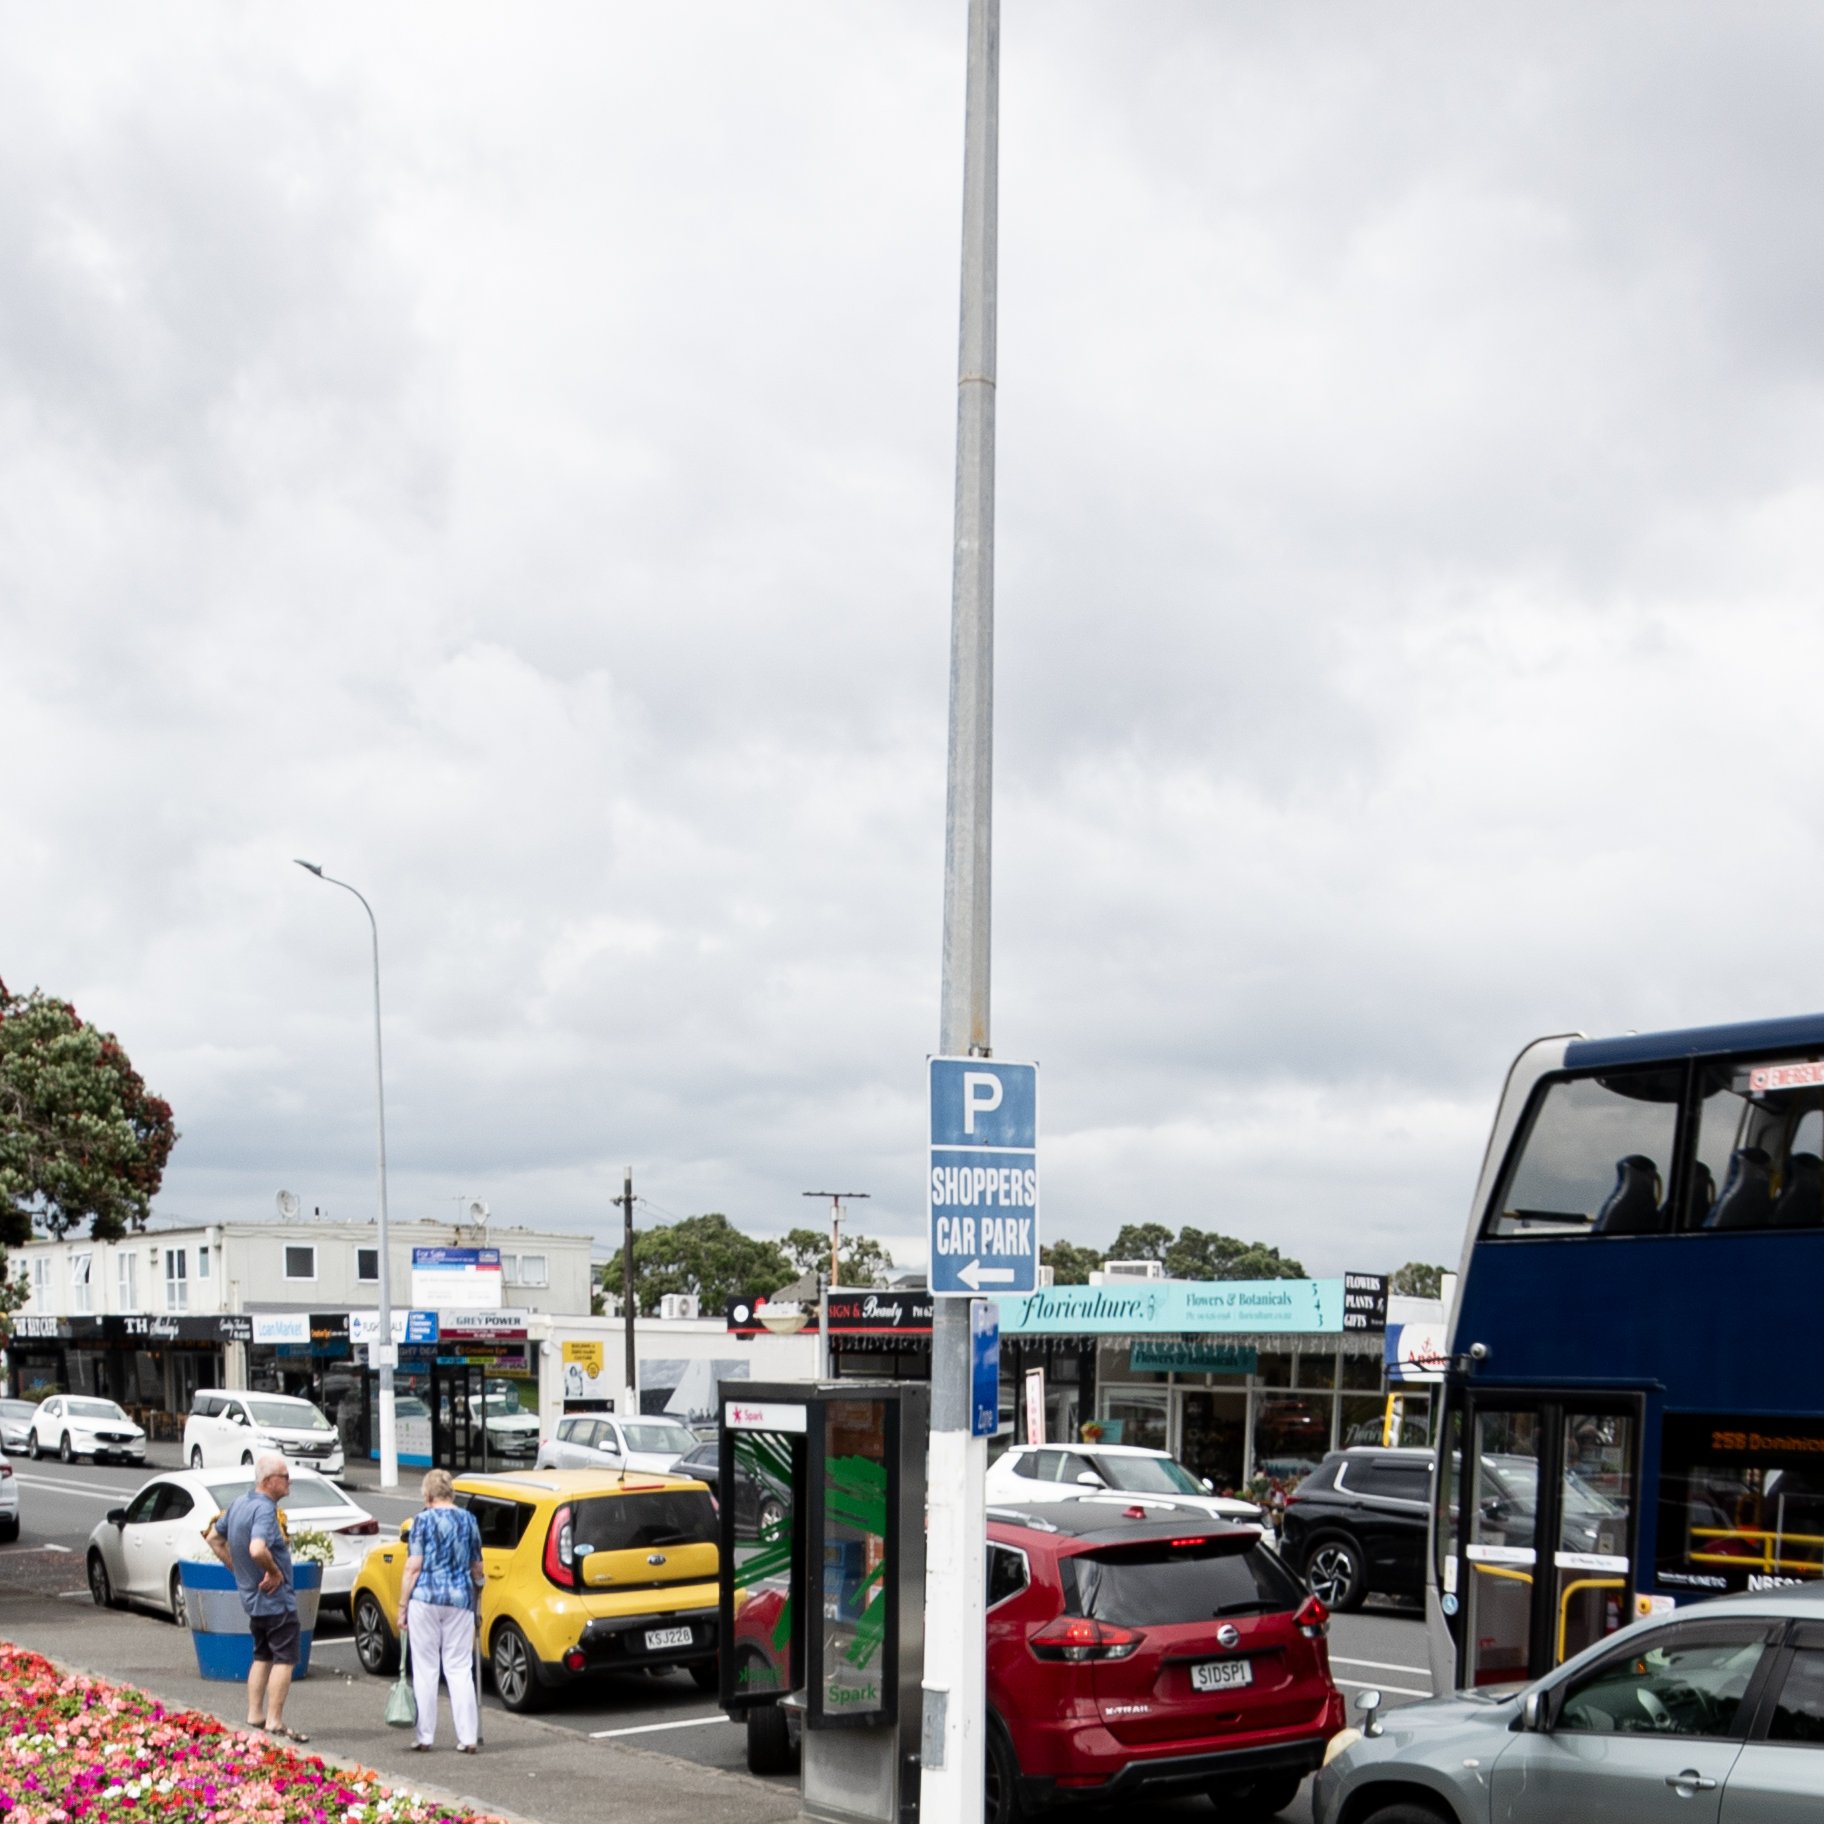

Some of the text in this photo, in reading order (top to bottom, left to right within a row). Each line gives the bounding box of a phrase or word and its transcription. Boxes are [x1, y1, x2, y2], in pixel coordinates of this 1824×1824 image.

[963, 1071, 1004, 1134] P
[932, 1166, 1036, 1207] SHOPPERS
[936, 1216, 1031, 1257] CAR PARK
[1345, 1275, 1380, 1291] FLOWERS
[1186, 1293, 1224, 1307] Flowers
[1239, 1291, 1292, 1305] Botanicals
[1345, 1294, 1374, 1310] PLANTS
[862, 1295, 903, 1326] Beauty
[457, 1317, 520, 1325] GREY POWER
[1344, 1314, 1367, 1327] GIFTS
[744, 1408, 764, 1422] Spark
[829, 1683, 876, 1705] Spark
